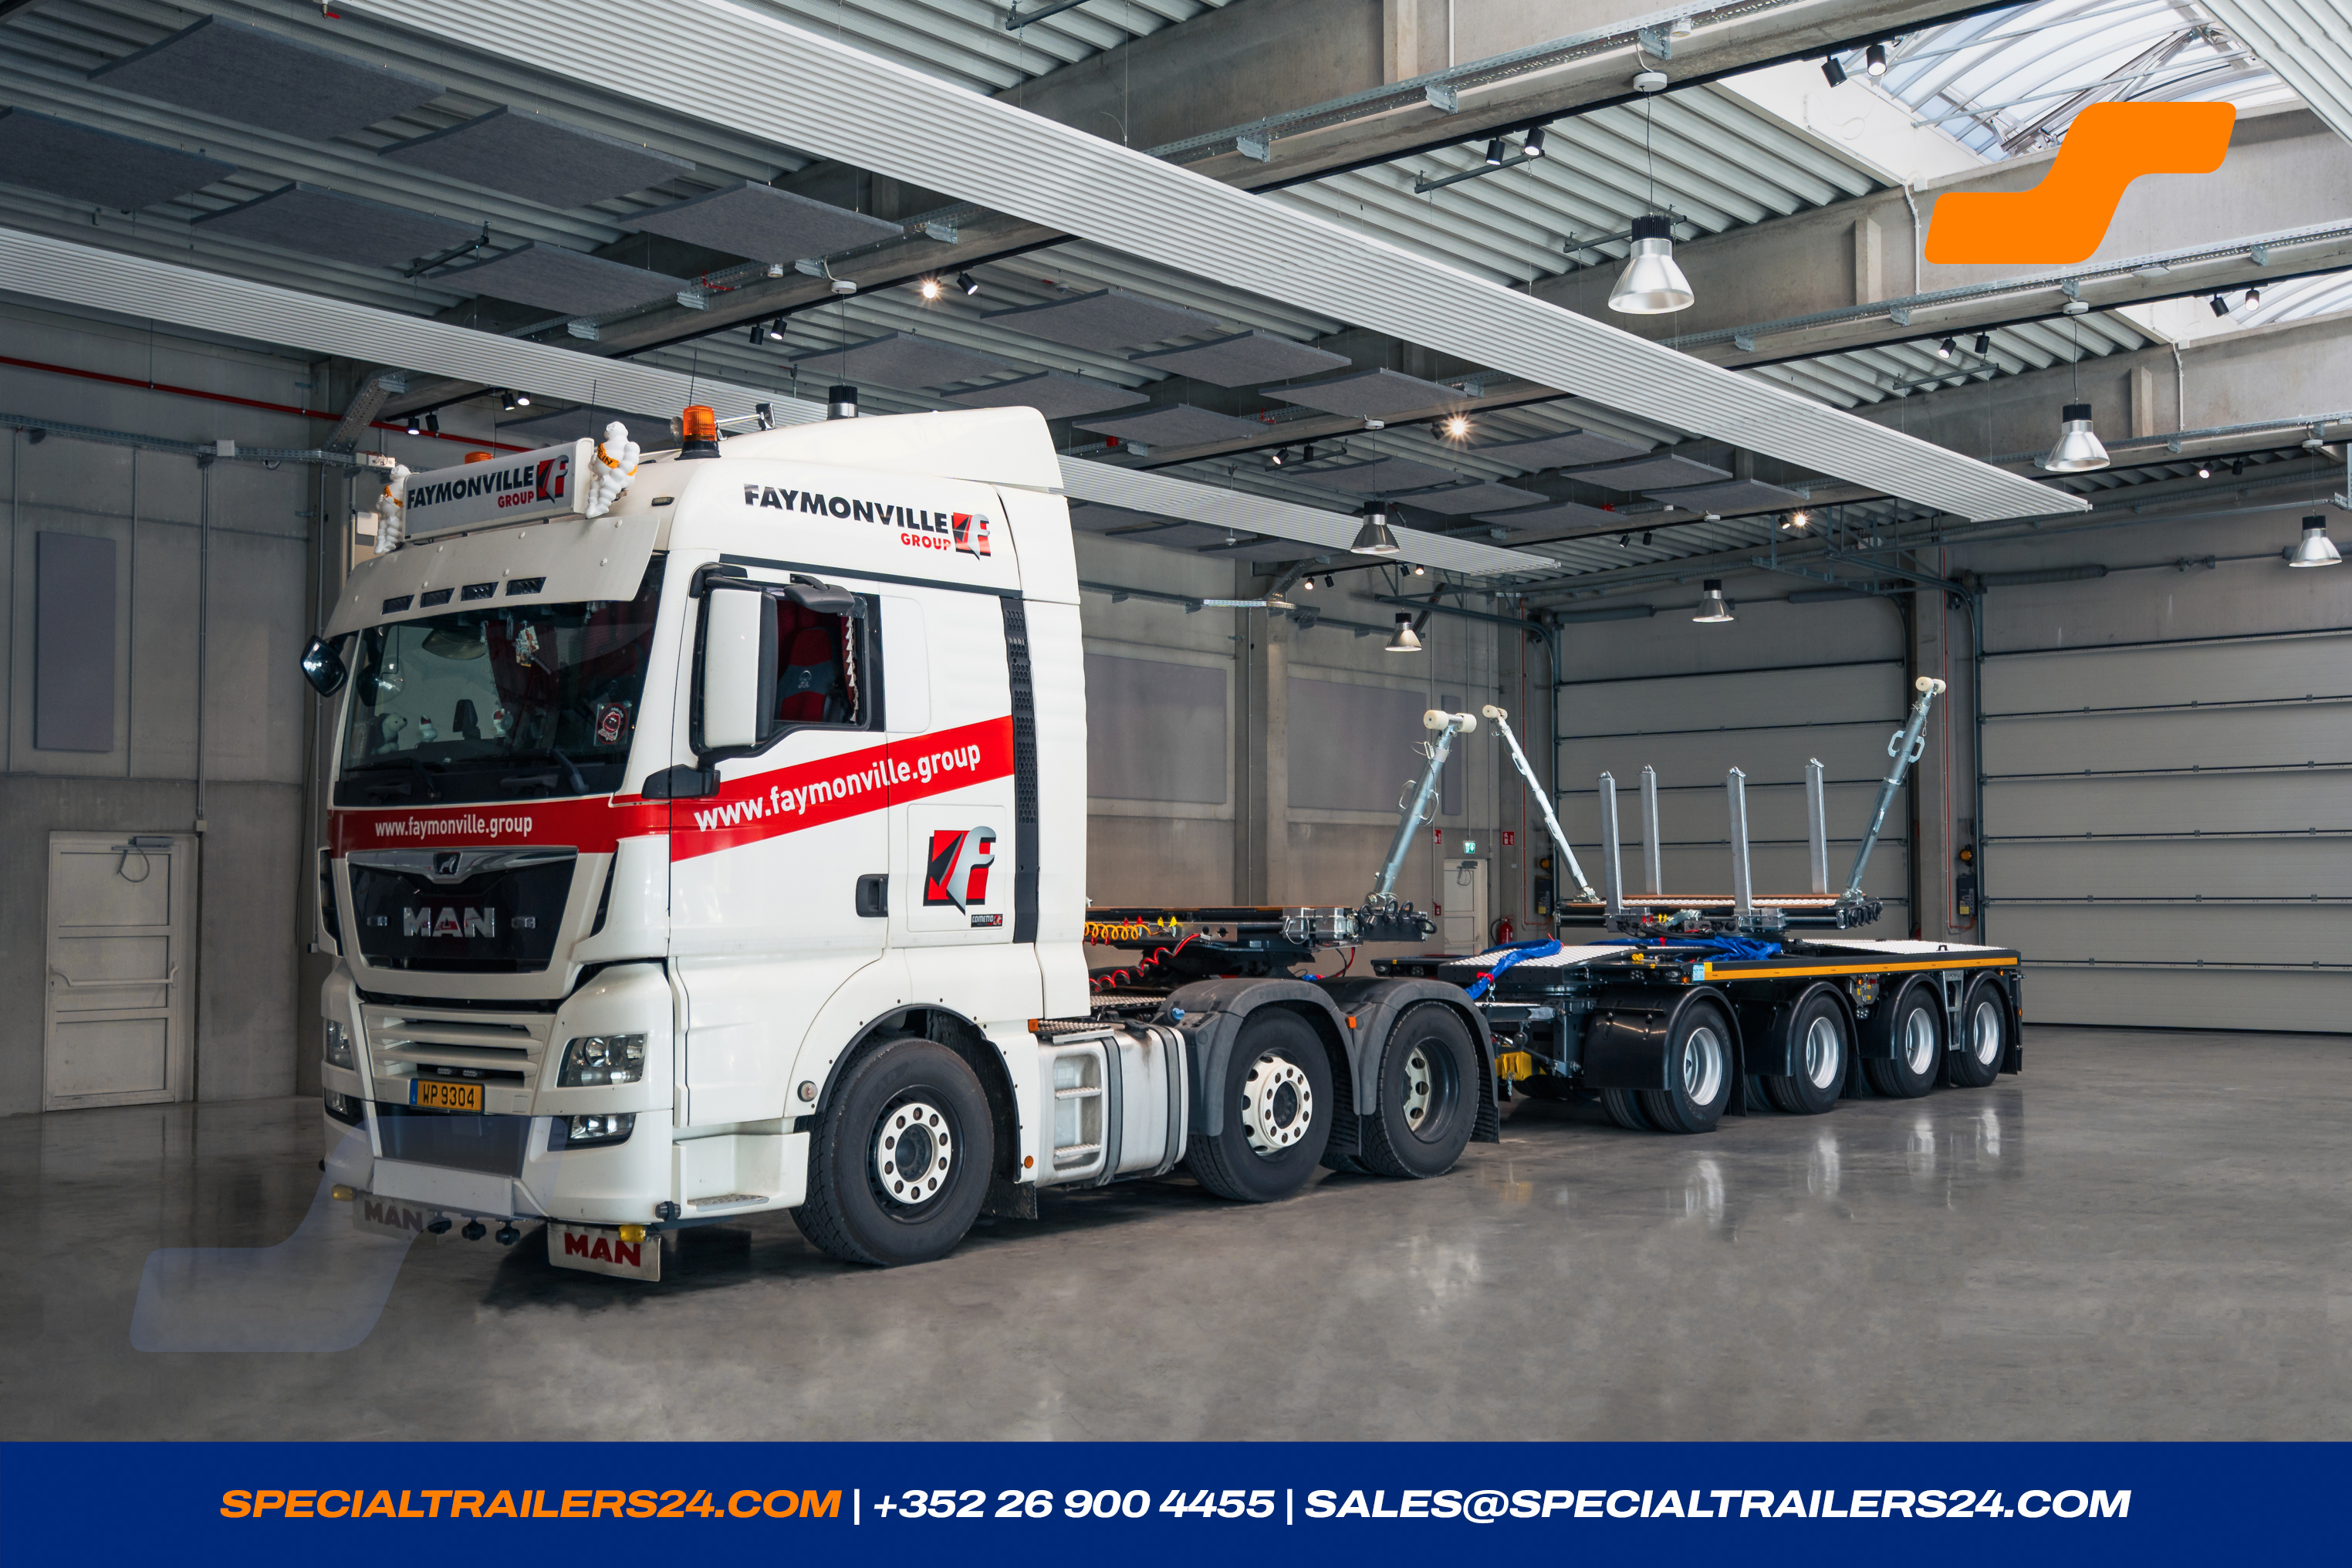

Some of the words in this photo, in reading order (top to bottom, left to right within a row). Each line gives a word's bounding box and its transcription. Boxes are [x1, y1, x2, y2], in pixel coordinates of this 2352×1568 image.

[407, 465, 535, 510] FAYMONVILLE
[498, 491, 535, 509] GROUP
[744, 483, 949, 534] FAYMONVILLE
[900, 532, 951, 551] GROUP
[694, 744, 981, 833] www.faymonville.group
[375, 815, 532, 840] www.faymonville.group
[403, 907, 495, 938] MAN
[424, 1084, 438, 1104] WP
[441, 1086, 475, 1108] 9304
[364, 1200, 424, 1234] MAN
[564, 1232, 641, 1269] MAN
